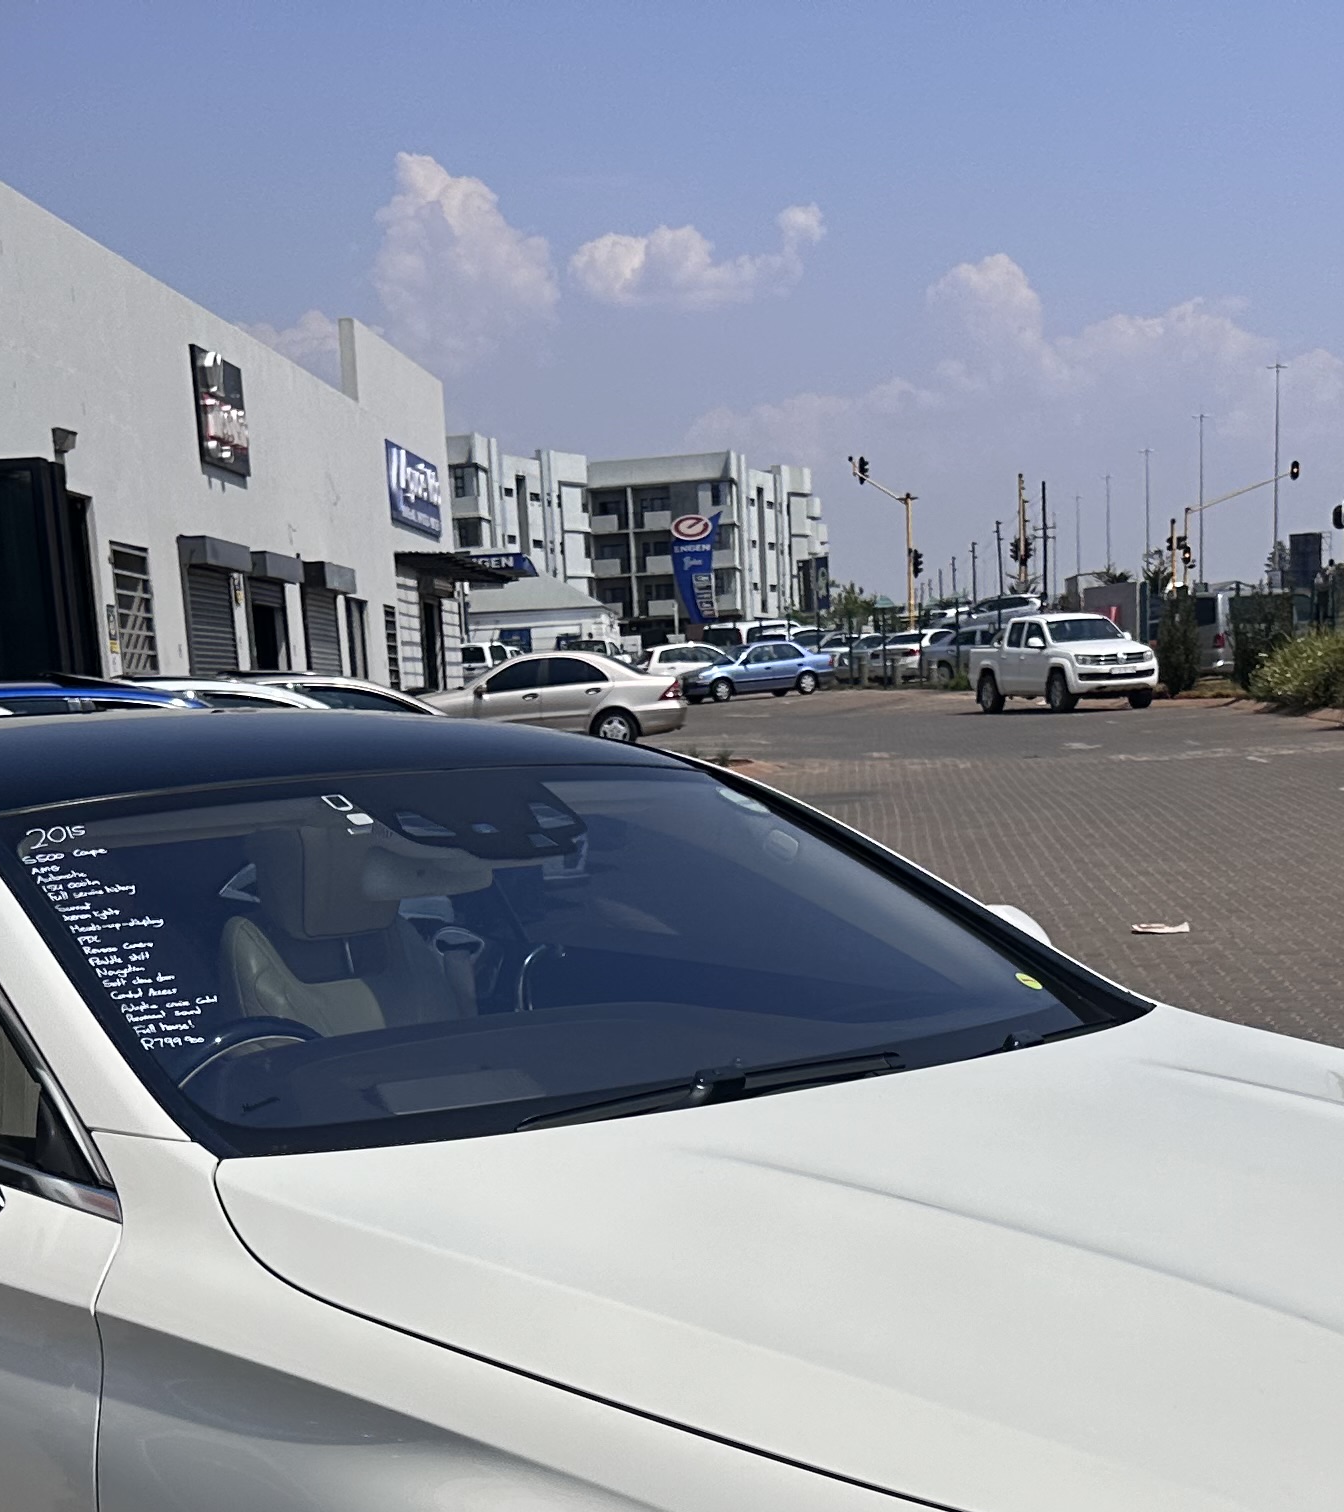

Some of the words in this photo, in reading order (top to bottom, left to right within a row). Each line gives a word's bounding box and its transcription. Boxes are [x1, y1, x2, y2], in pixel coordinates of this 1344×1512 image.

[674, 544, 711, 553] ENGEN
[26, 825, 86, 850] 2015
[31, 865, 61, 875] AMG
